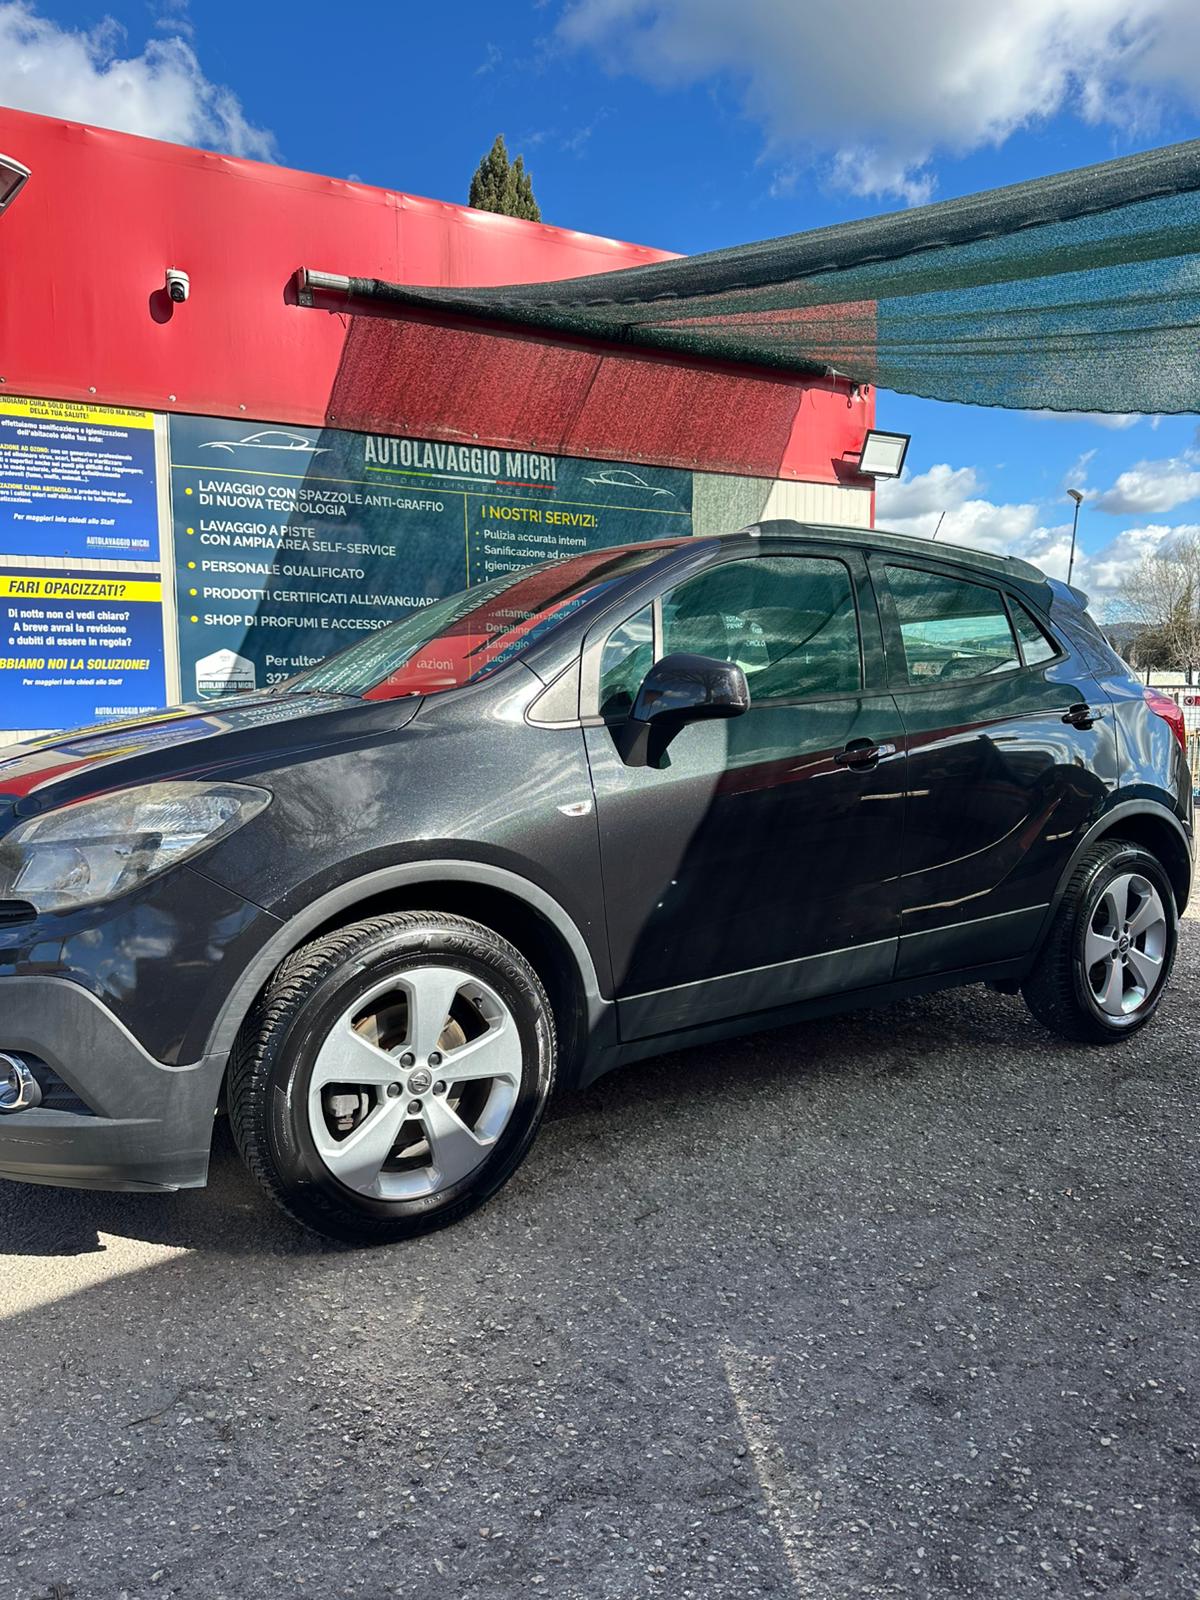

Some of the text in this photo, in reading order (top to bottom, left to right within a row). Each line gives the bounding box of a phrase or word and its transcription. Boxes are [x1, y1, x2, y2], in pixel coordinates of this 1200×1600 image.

[30, 399, 46, 407] CURA
[48, 402, 64, 410] SOLO
[65, 403, 84, 412] DELLA
[99, 406, 114, 414] AUTO
[127, 410, 146, 418] ANCHE
[364, 436, 556, 482] AUTOLAVAGGIO MICRI
[199, 480, 444, 512] LAVAGGIO CON SPAZZOLE ANTI-GRAFFIO
[199, 494, 347, 516] DI NUOVA TECNOLOGIA
[26, 514, 54, 523] maggiori
[68, 516, 86, 524] chiedi
[100, 518, 115, 526] Staff
[482, 505, 598, 528] I NOSTRI SERVIZI:
[200, 520, 315, 538] LAVAGGIO A PISTE
[86, 536, 150, 547] AUTOLAVAGGIO MICRI
[200, 534, 396, 556] CON AMPIA AREA SELF-SERVICE
[484, 530, 586, 547] Pulizia accurata interni
[484, 545, 545, 558] Sanificazione
[547, 548, 558, 559] ad
[202, 560, 365, 580] PERSONALE QUALIFICATO
[485, 561, 533, 572] Igienizza
[8, 581, 126, 596] FARI OPACIZZATI?
[203, 587, 270, 601] PRODOTTI
[272, 590, 347, 604] CERTIFICATI
[8, 608, 18, 618] Di
[20, 609, 44, 619] notte
[65, 610, 74, 620] ci
[76, 611, 95, 620] vedi
[97, 611, 130, 621] chiaro?
[13, 622, 126, 633] A breve avrai la revisione
[204, 615, 242, 627] SHOP
[244, 616, 258, 627] DI
[260, 617, 318, 629] PROFUMI
[321, 618, 328, 628] E
[17, 636, 43, 645] dubiti
[46, 636, 54, 646] di
[89, 637, 97, 646] in
[99, 637, 132, 648] regola?
[486, 639, 529, 650] Lavaggio
[48, 659, 68, 669] NOI
[70, 659, 84, 669] LA
[87, 659, 150, 670] SOLUZIONE!
[266, 655, 289, 666] Per
